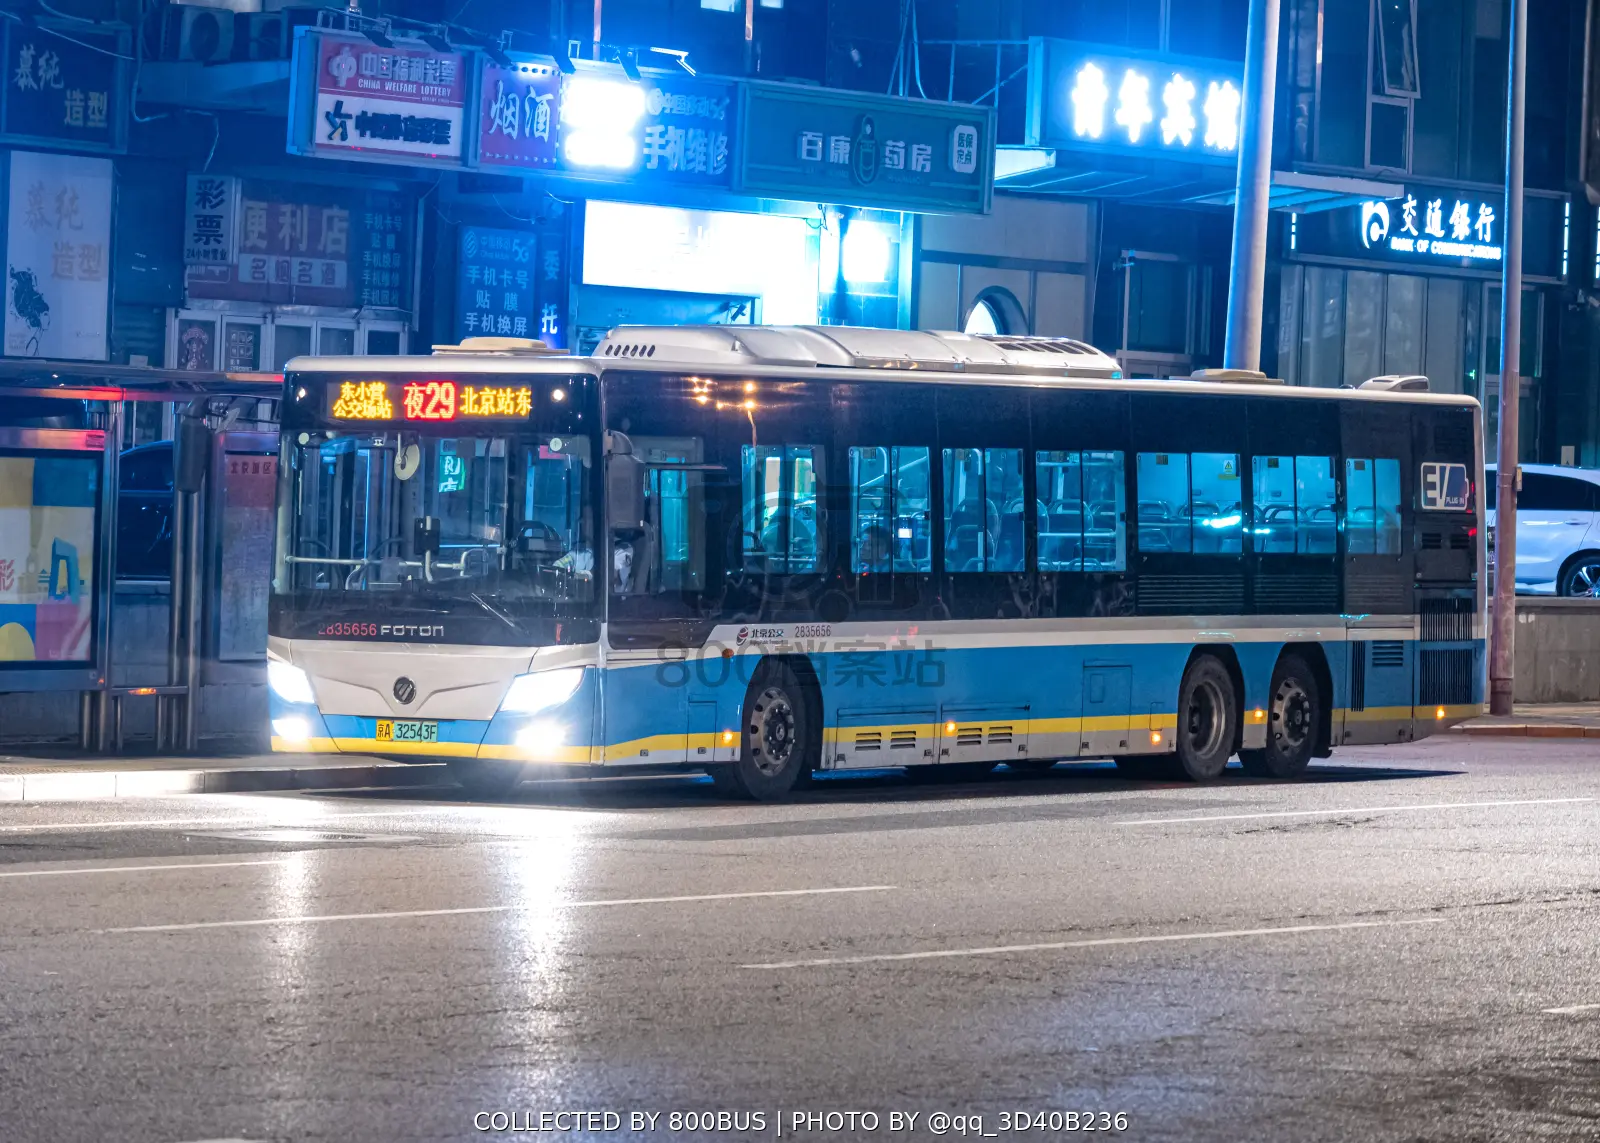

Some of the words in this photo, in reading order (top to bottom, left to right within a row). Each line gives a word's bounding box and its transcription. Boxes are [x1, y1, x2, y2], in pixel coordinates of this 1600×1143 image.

[358, 78, 381, 90] CHINA
[384, 81, 417, 94] WELFARE
[420, 86, 451, 97] LOTTERY
[64, 88, 108, 127] 造型
[488, 79, 554, 143] 烟酒
[643, 125, 728, 175] 手机维修
[801, 130, 851, 165] 百康
[884, 140, 932, 173] 药房
[194, 178, 225, 246] 彩票
[243, 199, 349, 254] 便利店
[1417, 239, 1429, 252] OF
[466, 265, 529, 290] 手机卡号
[475, 289, 519, 312] 贴膜
[464, 312, 528, 337] 手机换屏
[404, 381, 456, 419] 夜29
[459, 386, 532, 416] 北京站东
[318, 622, 377, 636] 2835656
[380, 625, 444, 637] FOTON
[751, 628, 785, 638] 北京公交
[794, 624, 832, 638] 2835656
[377, 723, 391, 738] 京A
[396, 723, 437, 740] 32543F
